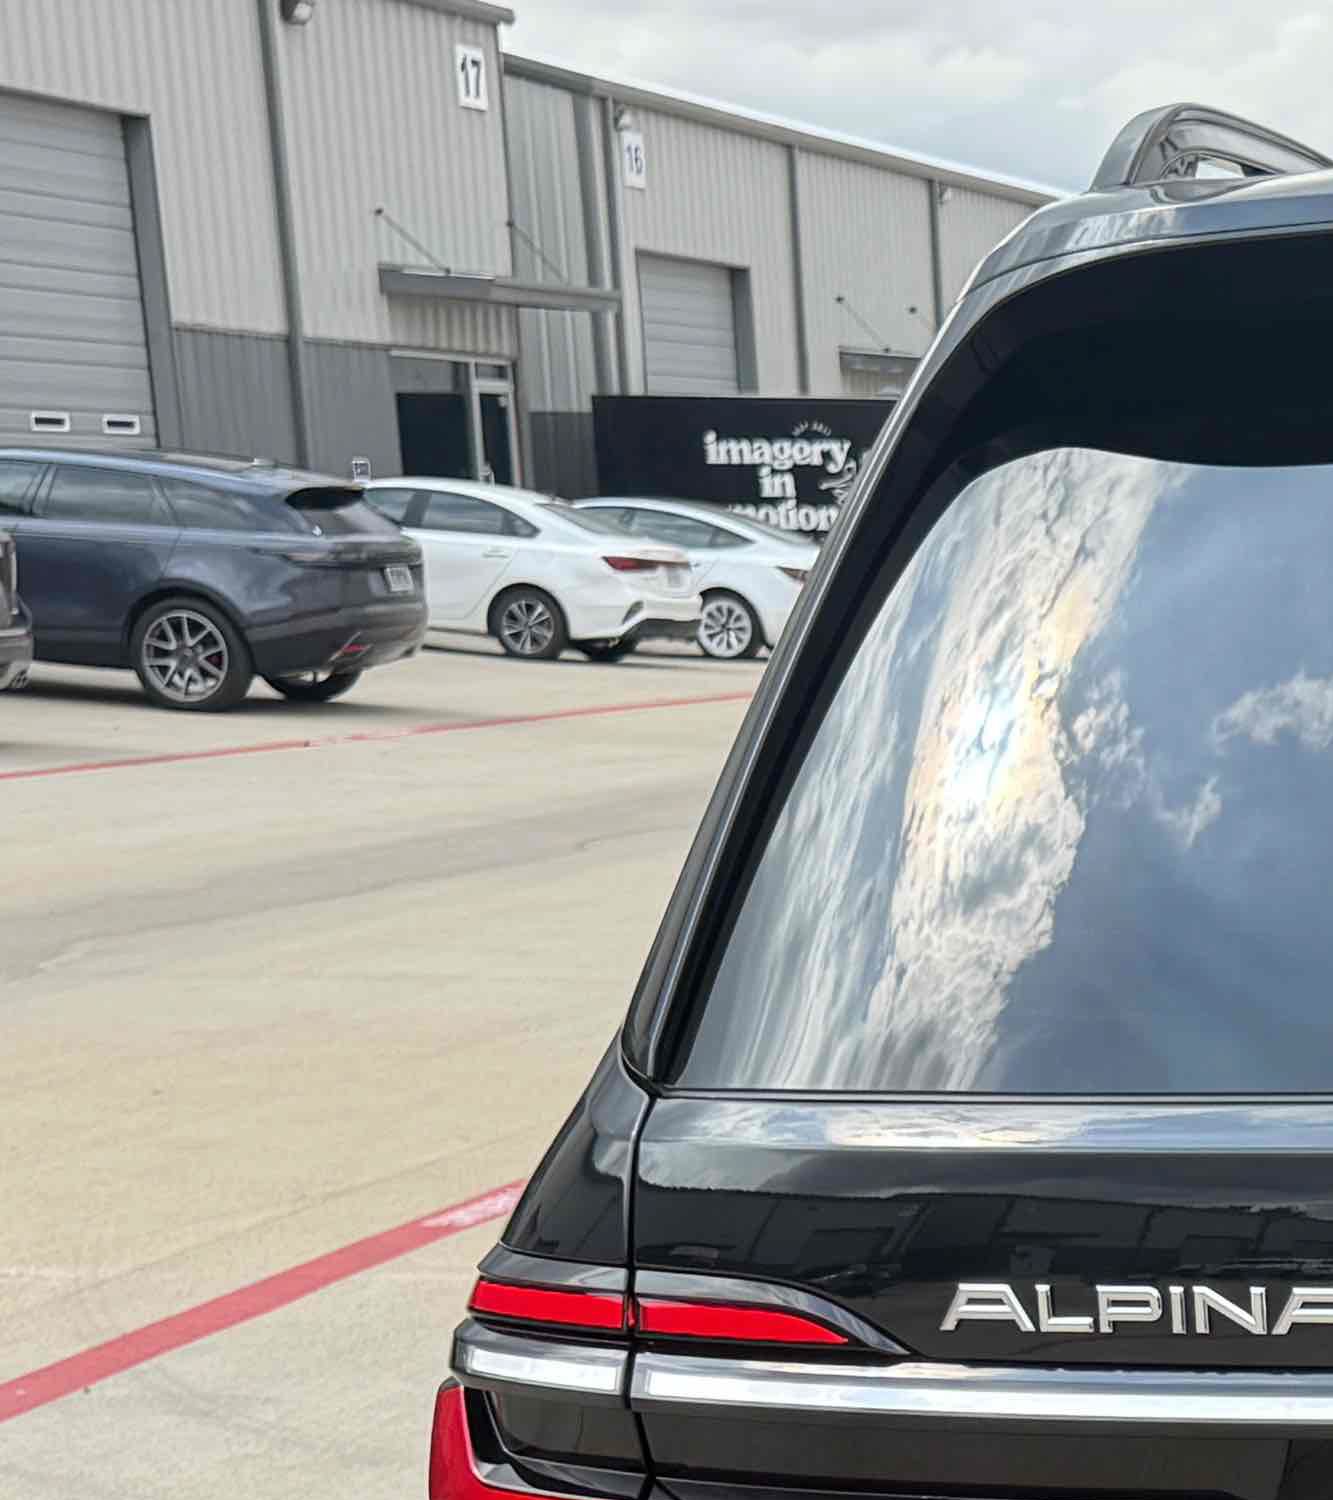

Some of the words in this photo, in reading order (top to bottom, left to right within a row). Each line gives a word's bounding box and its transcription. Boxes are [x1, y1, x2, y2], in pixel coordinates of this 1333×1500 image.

[461, 56, 481, 97] 17
[626, 144, 643, 175] 16
[704, 429, 851, 474] imagery
[759, 465, 797, 498] in
